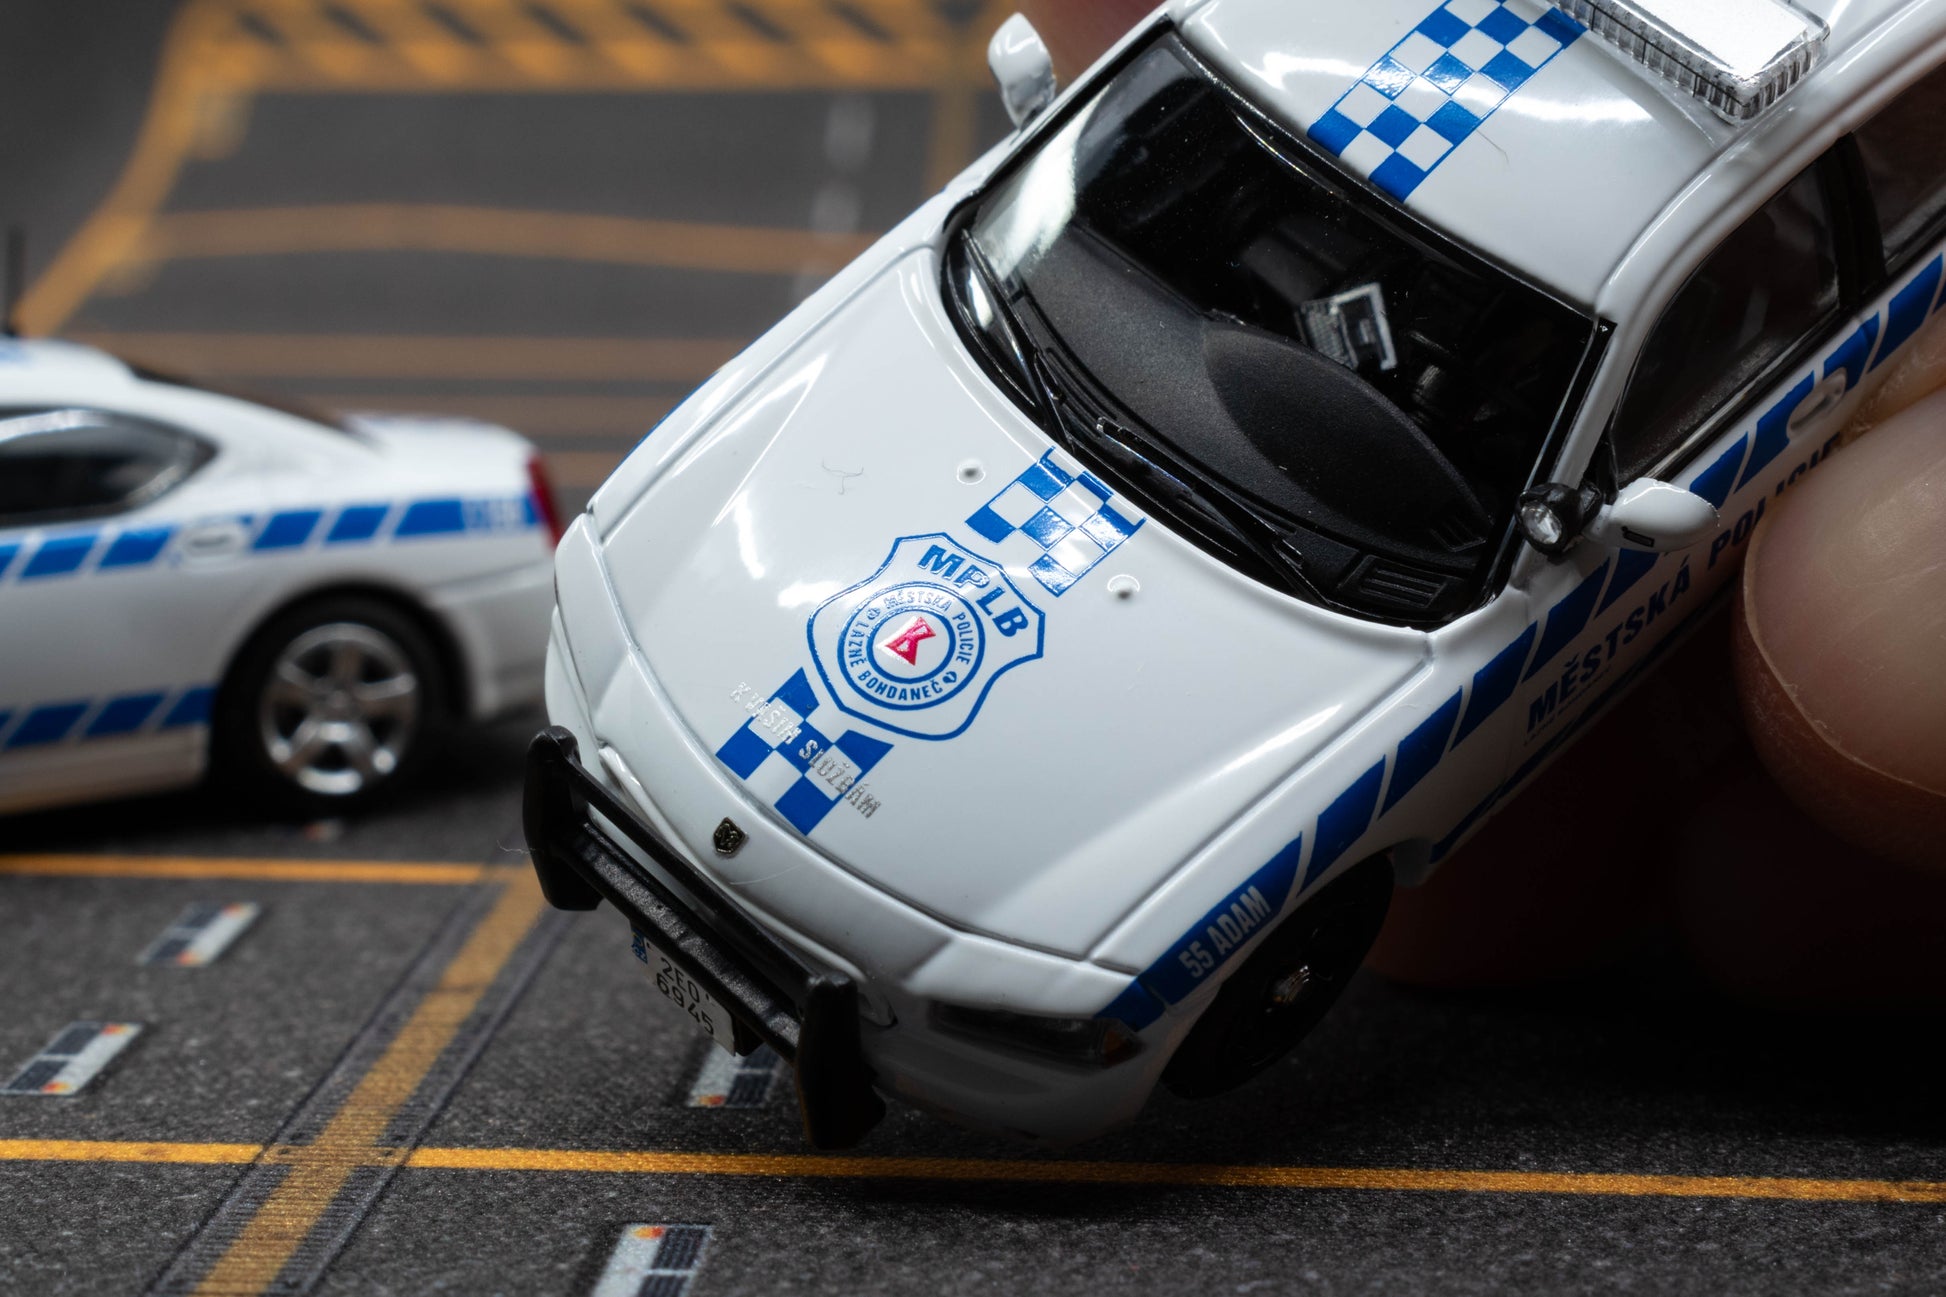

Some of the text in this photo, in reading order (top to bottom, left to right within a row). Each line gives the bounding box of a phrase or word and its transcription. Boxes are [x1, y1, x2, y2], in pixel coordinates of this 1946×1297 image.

[917, 544, 1029, 637] MPLB
[952, 612, 974, 665] POLICIE
[1527, 557, 1691, 732] MĚSTSKÁ
[858, 670, 943, 701] BOHDANEČ
[1179, 886, 1271, 978] 55 ADAM
[656, 973, 714, 1035] 6945
